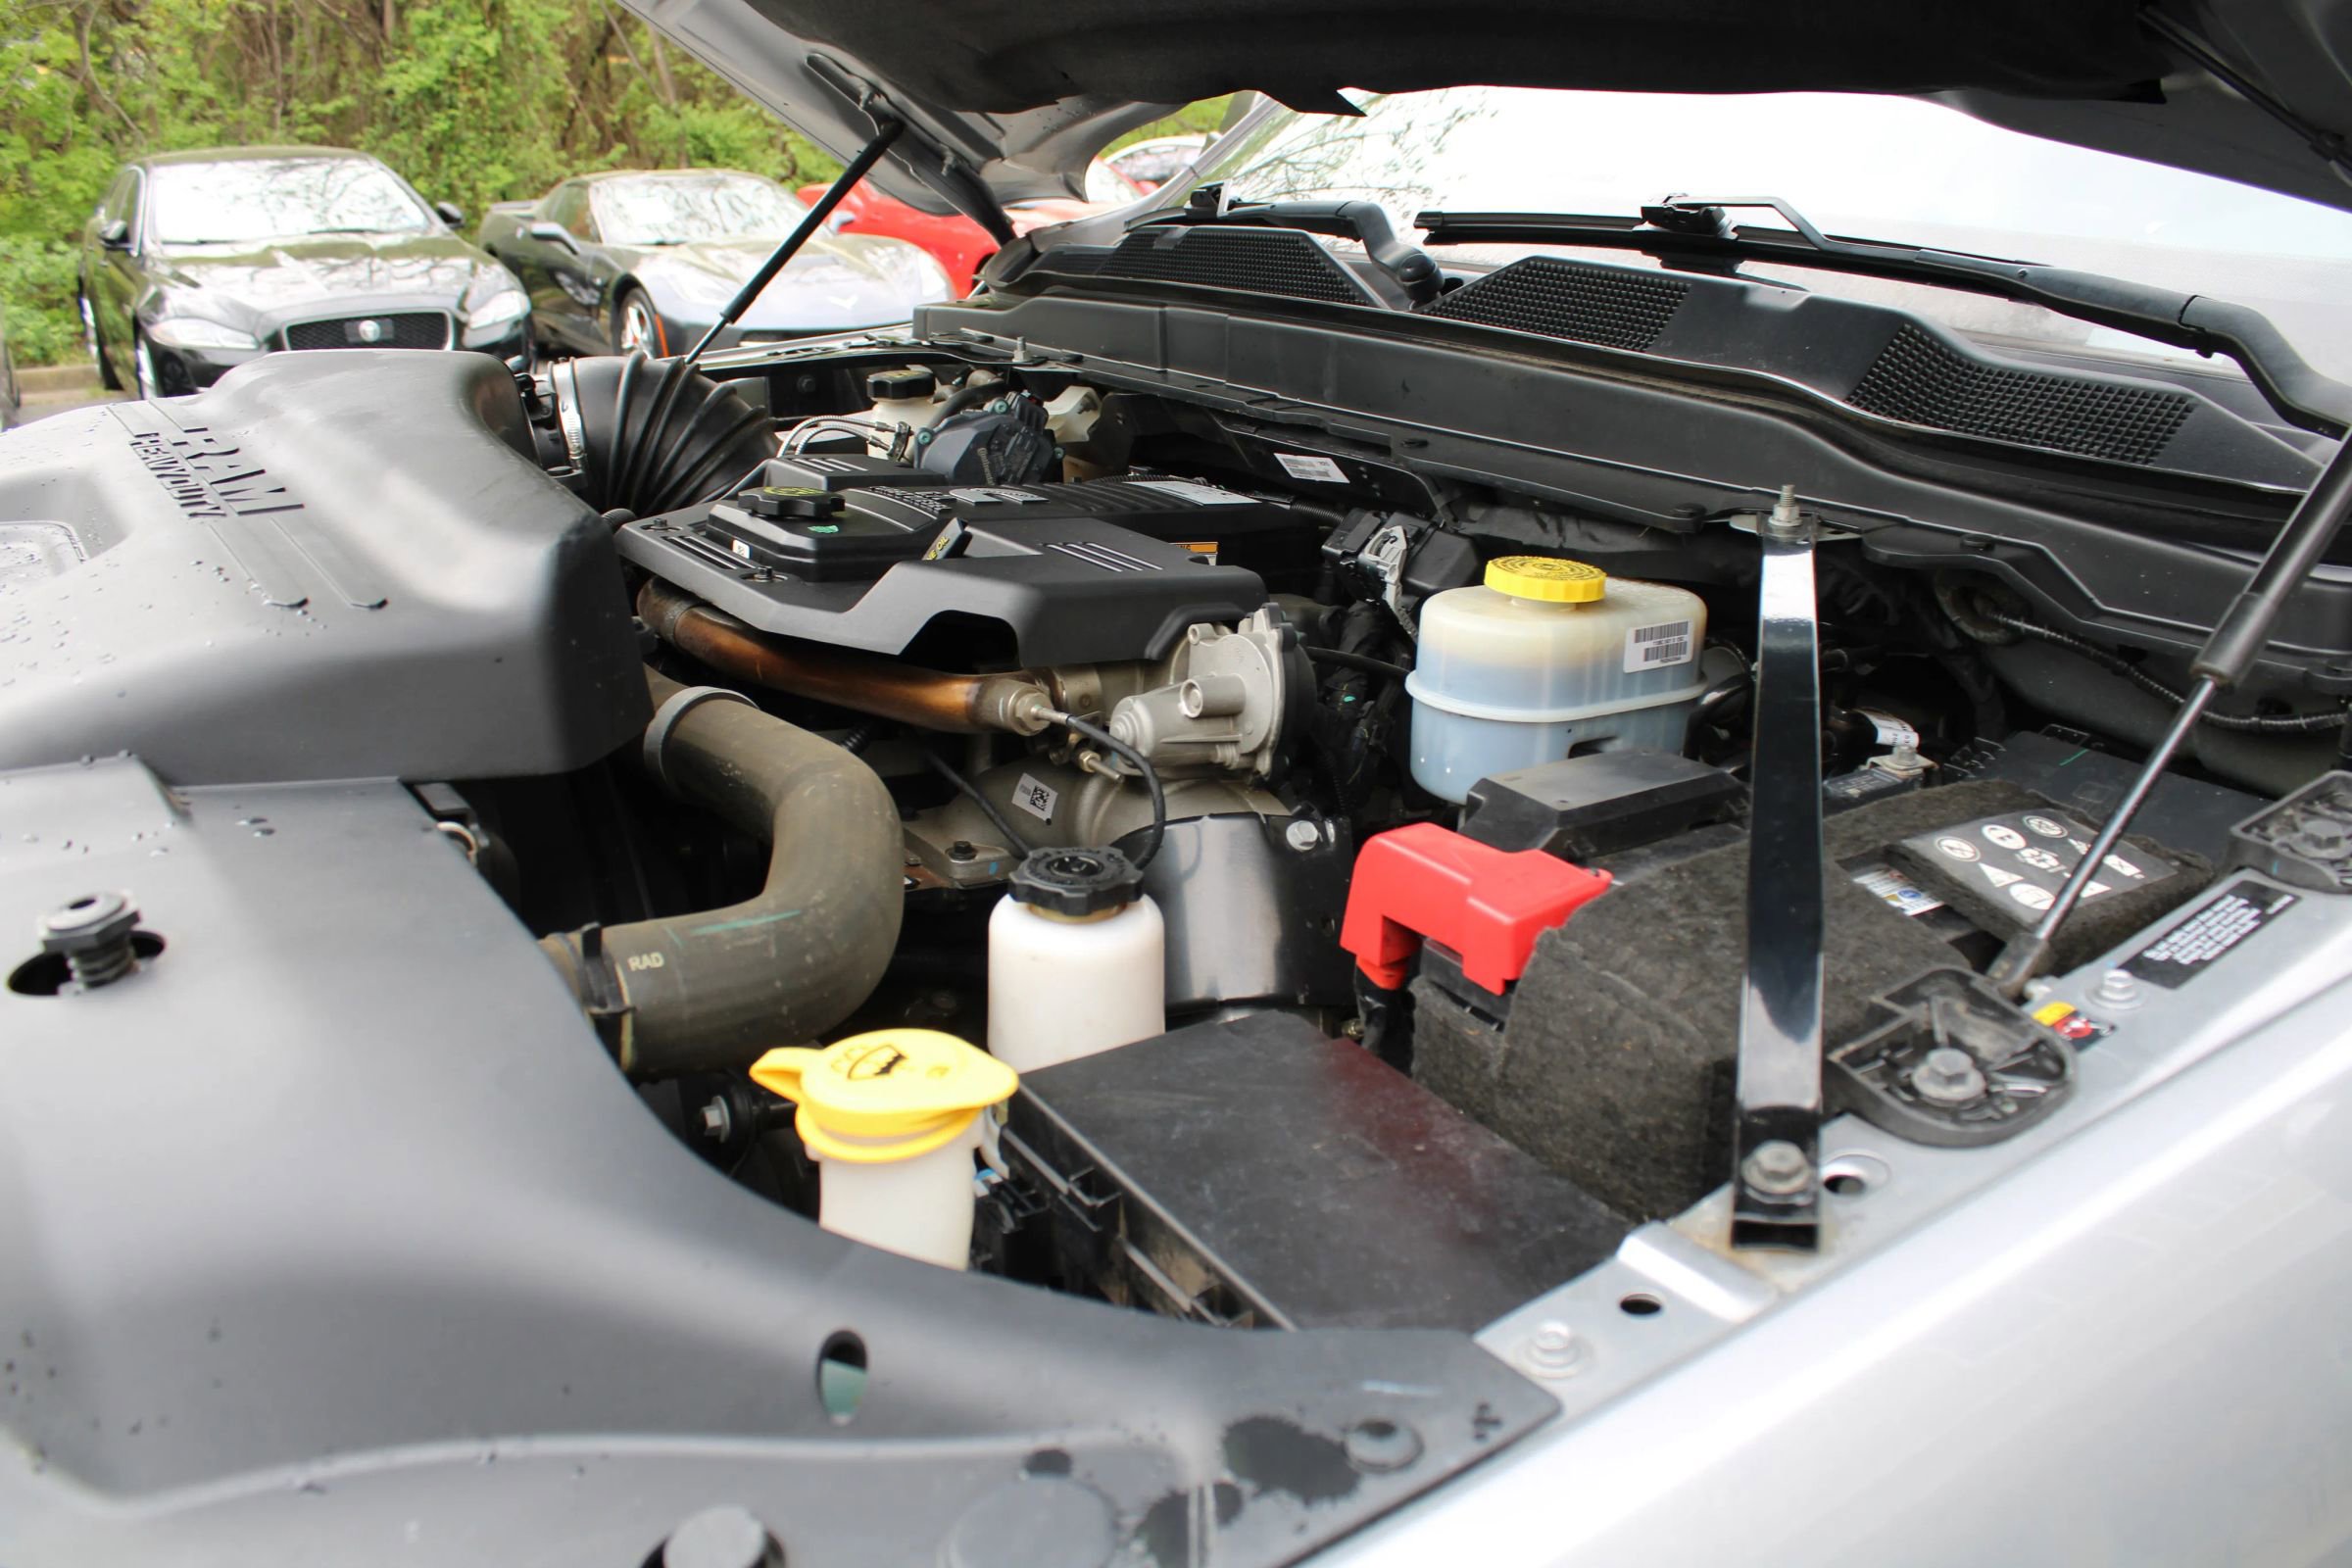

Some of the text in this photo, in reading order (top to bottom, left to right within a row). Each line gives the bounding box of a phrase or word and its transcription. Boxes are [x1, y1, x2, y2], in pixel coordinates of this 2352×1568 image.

[129, 437, 227, 517] HEAVY DUTY
[168, 430, 305, 516] RAM
[936, 536, 950, 551] OIL
[627, 952, 663, 971] RAD
